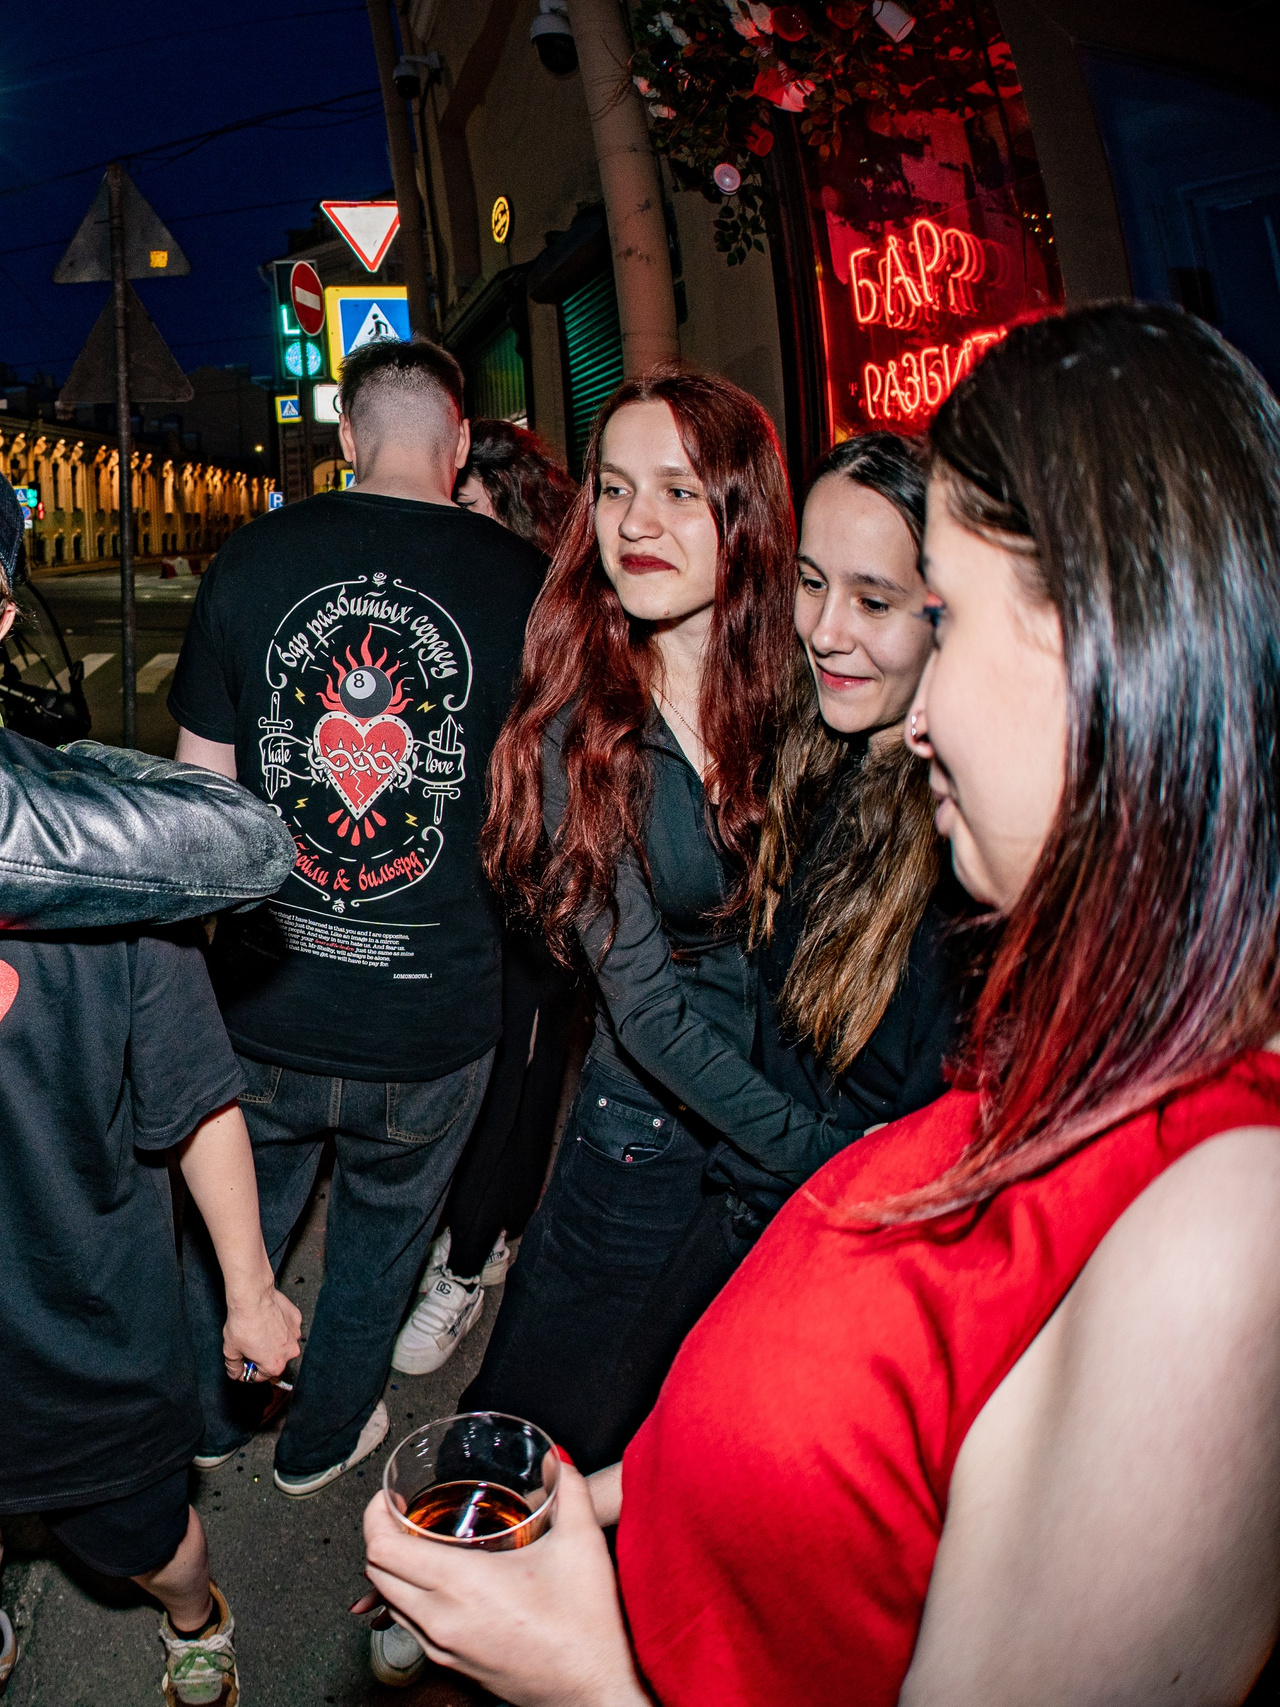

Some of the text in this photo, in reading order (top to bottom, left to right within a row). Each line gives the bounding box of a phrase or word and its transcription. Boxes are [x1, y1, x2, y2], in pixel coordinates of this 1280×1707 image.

[851, 219, 940, 323] БАР
[275, 585, 458, 679] бар разбитых сердец
[353, 673, 365, 688] 8
[268, 737, 292, 764] hate
[425, 750, 455, 774] love
[333, 869, 351, 891] &
[358, 851, 424, 891] бильярд
[355, 947, 366, 955] just
[435, 1280, 452, 1295] DG
